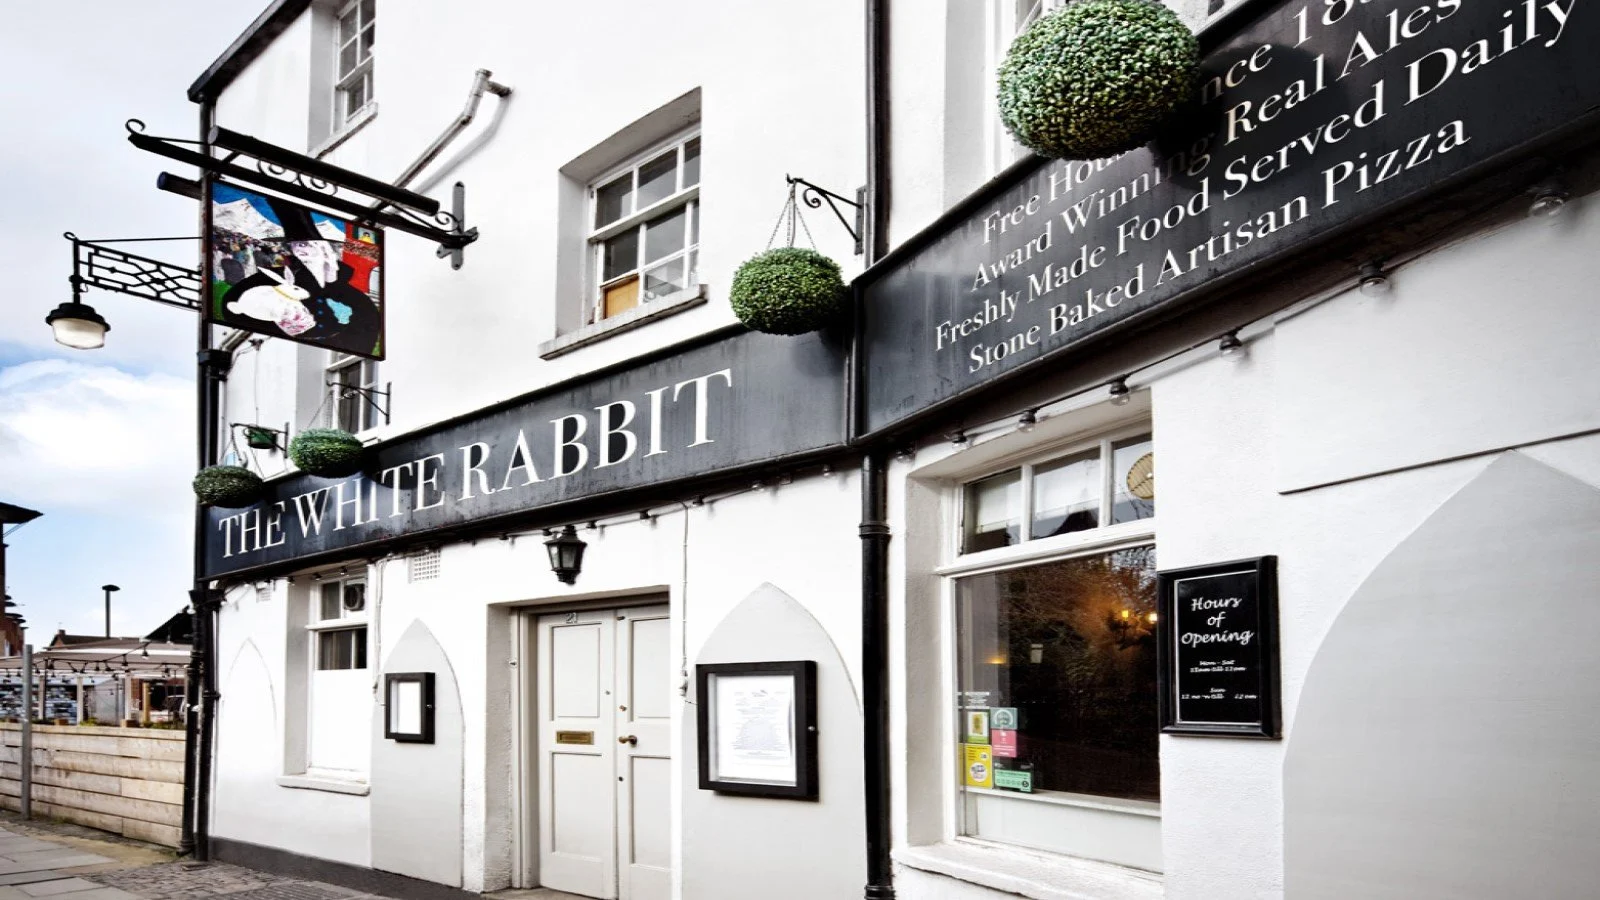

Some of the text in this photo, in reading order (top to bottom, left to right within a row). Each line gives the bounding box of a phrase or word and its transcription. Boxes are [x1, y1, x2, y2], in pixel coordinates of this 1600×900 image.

[935, 0, 1576, 351] Freshly Made Food Served Daily
[970, 0, 1462, 292] Award Winning Real Ales
[983, 194, 1041, 245] Free
[1201, 43, 1273, 105] nce
[969, 120, 1472, 374] Stone Baked Artisan Pizza
[218, 368, 732, 558] THE WHITE RABBIT
[1181, 630, 1254, 648] Opening
[1191, 597, 1242, 612] Hours
[1207, 611, 1227, 628] of
